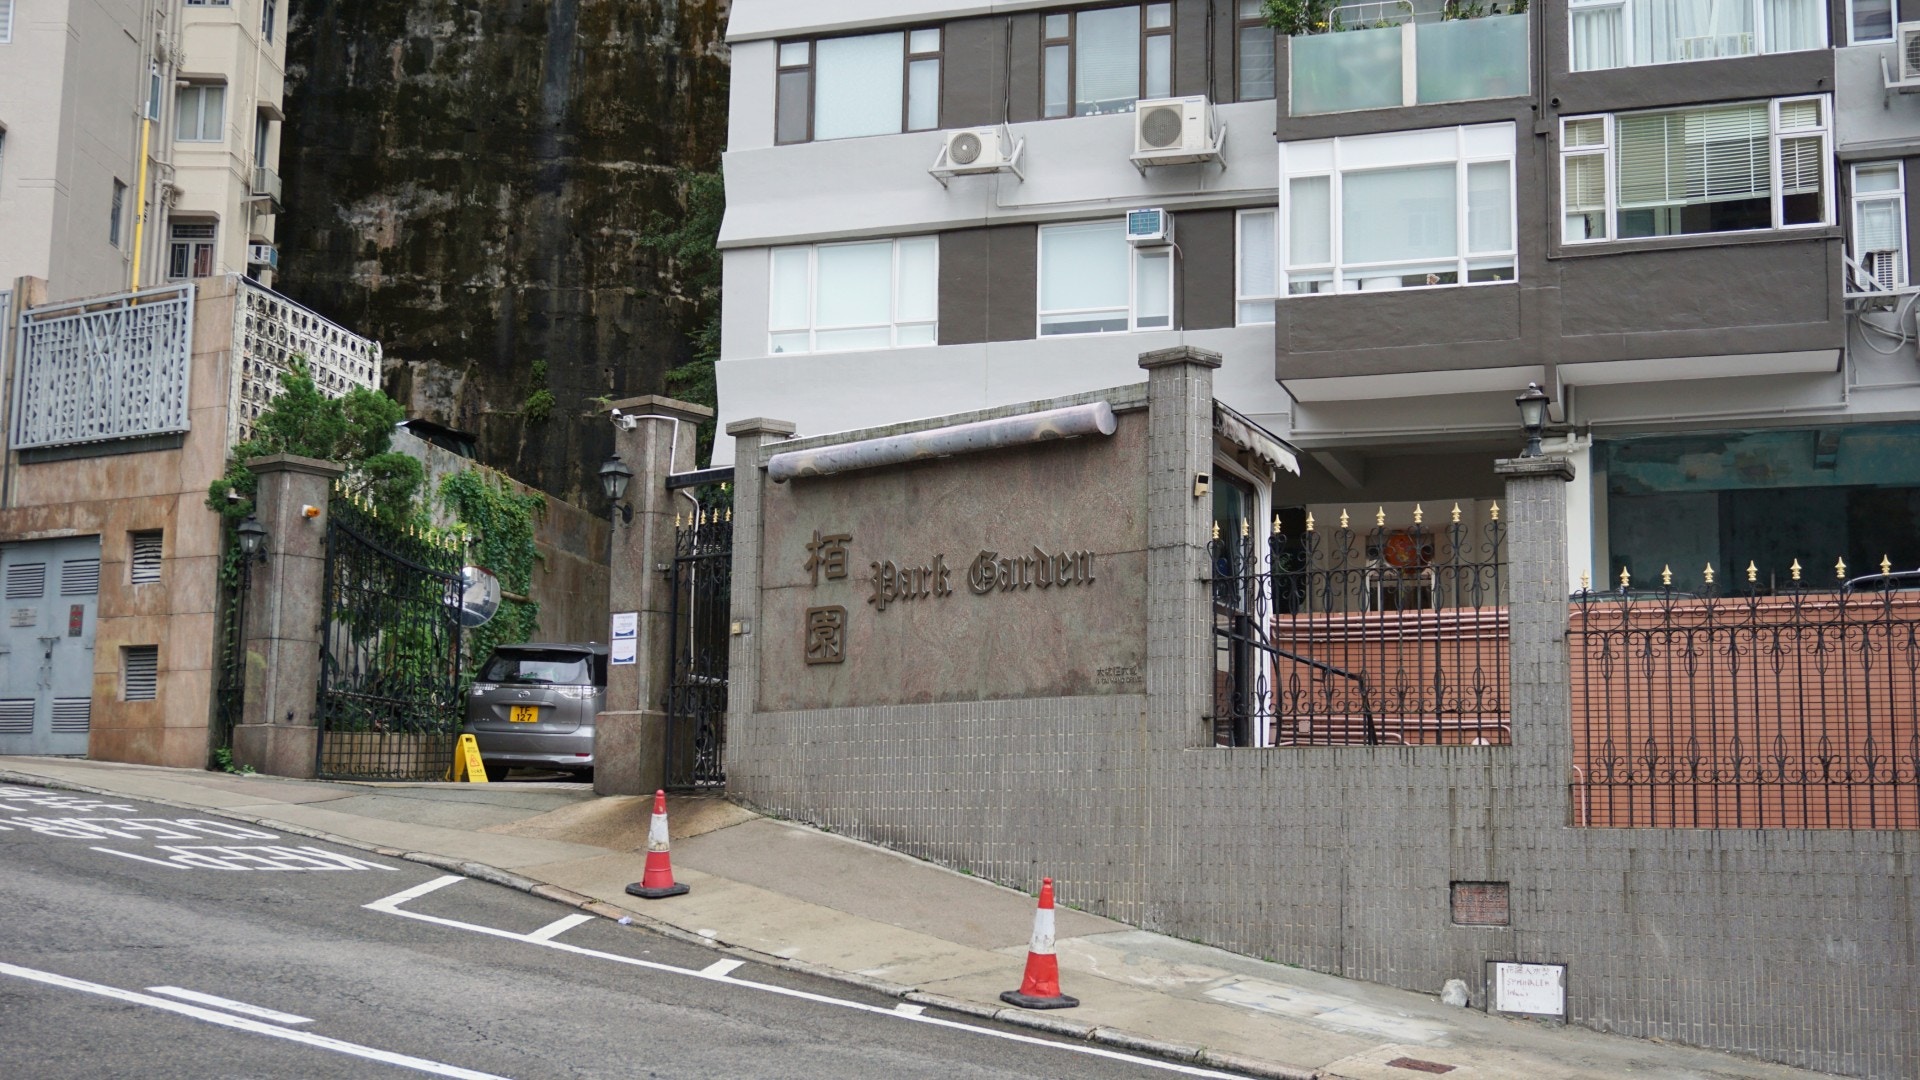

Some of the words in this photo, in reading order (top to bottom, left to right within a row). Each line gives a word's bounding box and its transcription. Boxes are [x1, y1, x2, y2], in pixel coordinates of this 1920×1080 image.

[804, 530, 852, 665] 栢園
[867, 553, 953, 611] Park
[967, 545, 1096, 595] Garden
[519, 706, 531, 714] TF
[155, 845, 400, 871] KEEP
